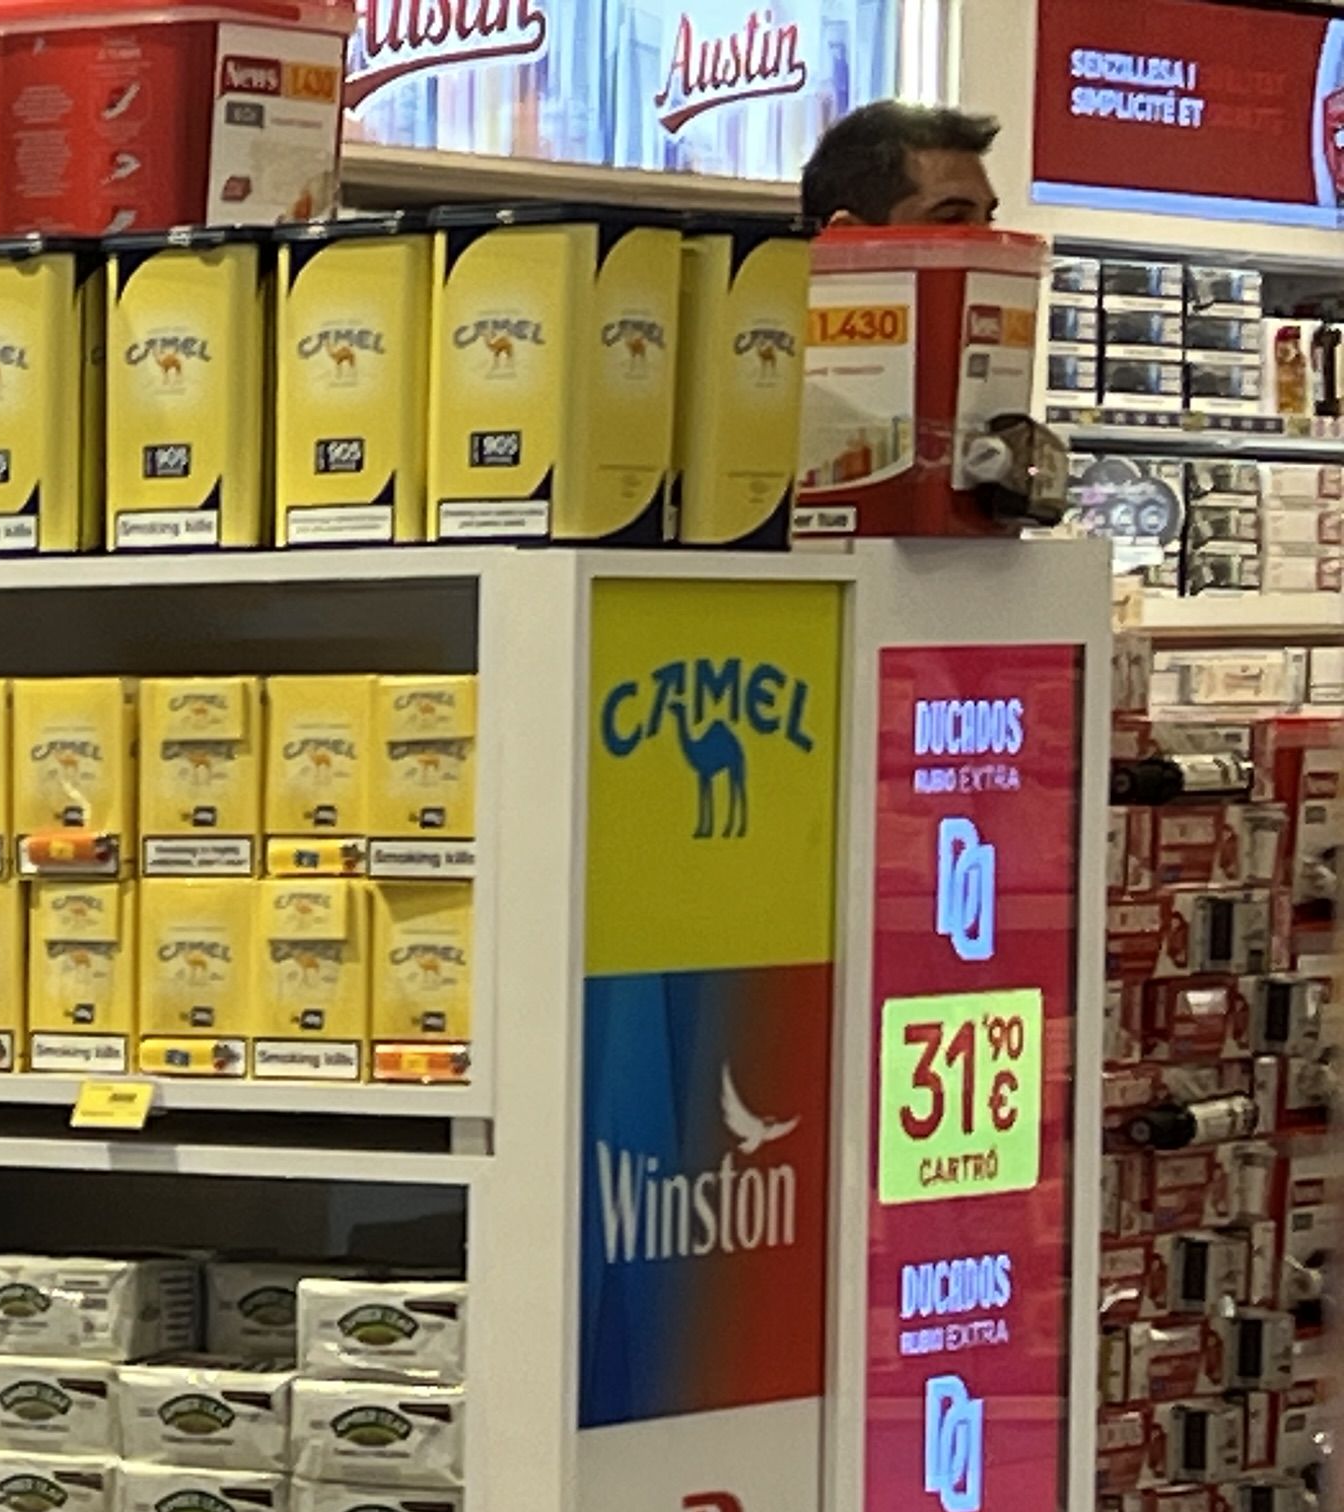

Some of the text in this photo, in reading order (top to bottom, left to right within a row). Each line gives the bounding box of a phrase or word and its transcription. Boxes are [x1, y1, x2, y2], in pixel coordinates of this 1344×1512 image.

[655, 10, 807, 105] Austin
[223, 58, 281, 93] News
[453, 318, 545, 350] CAMEL
[601, 319, 667, 350] CAMEL
[733, 326, 796, 356] CAMEL
[817, 310, 900, 342] 1.430
[125, 336, 211, 365] CAMEL
[298, 329, 387, 360] CAMEL
[169, 694, 231, 713] CAMEL
[394, 692, 456, 713] CAMEL
[601, 659, 814, 757] CAMEL
[914, 698, 1024, 757] DUCADOS
[31, 741, 104, 764] CAMEL
[283, 737, 358, 763] CAMEL
[958, 763, 1021, 792] EXTRA
[50, 893, 104, 912] CAMEL
[274, 893, 335, 911] CAMEL
[158, 940, 231, 964] CAMEL
[390, 945, 467, 967] CAMEL
[899, 1020, 976, 1141] 31
[988, 1070, 1019, 1133] €
[918, 1146, 999, 1187] CARTRÓ
[597, 1140, 796, 1265] Winston
[900, 1254, 1012, 1320] DUCADOS
[946, 1318, 1010, 1351] EXTRA
